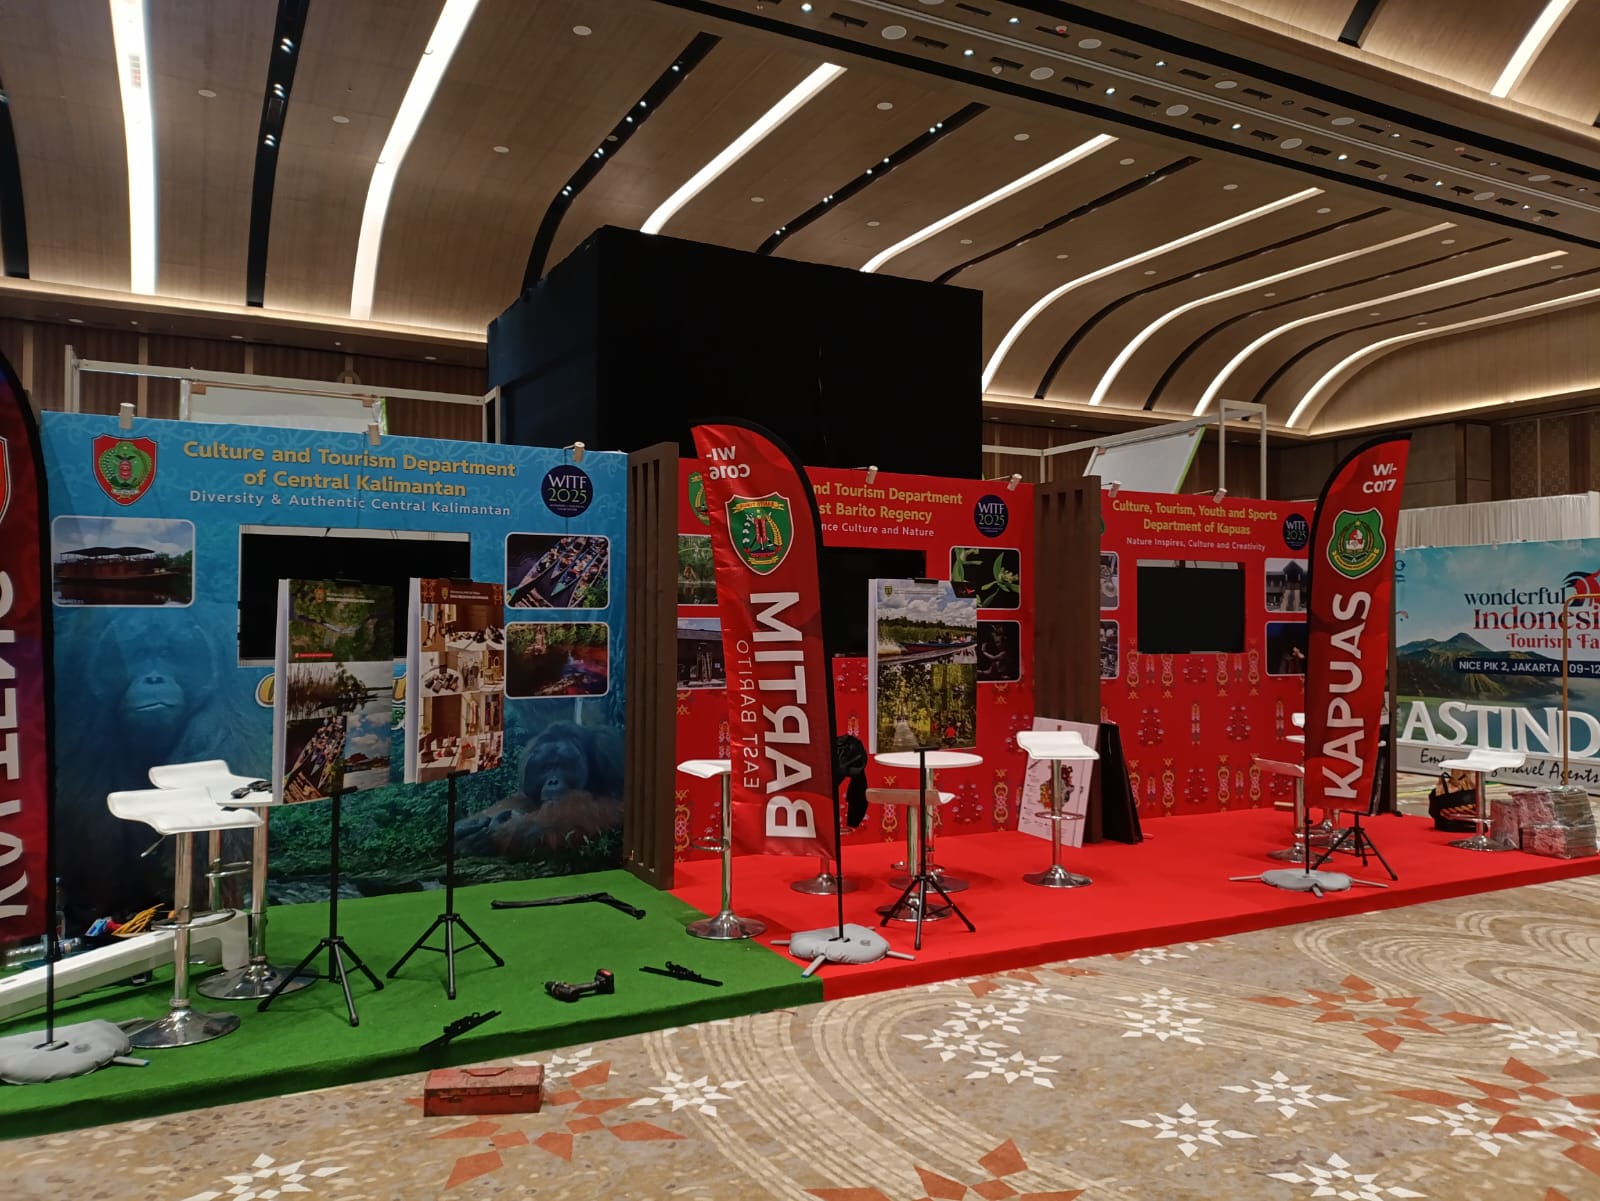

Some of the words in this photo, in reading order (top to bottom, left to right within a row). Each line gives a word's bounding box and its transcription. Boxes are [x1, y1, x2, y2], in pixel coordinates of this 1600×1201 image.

[183, 440, 265, 461] Culture
[271, 447, 311, 463] and
[318, 448, 396, 469] Tourism
[403, 454, 516, 477] Department
[243, 468, 267, 486] of
[273, 470, 349, 490] Central
[356, 474, 467, 497] Kalimantan
[548, 473, 587, 489] WITF
[189, 489, 265, 507] Diversity
[271, 493, 282, 505] &
[289, 495, 365, 509] Authentic
[371, 498, 426, 512] Central
[432, 501, 511, 516] Kalimantan
[547, 487, 587, 505] 2025
[813, 482, 831, 495] nd
[834, 482, 885, 499] Tourism
[889, 487, 963, 505] Department
[819, 502, 832, 515] st
[836, 502, 876, 517] Barito
[880, 505, 933, 525] Regency
[978, 501, 1005, 515] WITF
[1112, 500, 1152, 514] Culture,
[1155, 502, 1195, 516] Tourism,
[1198, 505, 1226, 518] Youth
[1228, 507, 1246, 519] and
[1248, 508, 1278, 522] Sports
[841, 522, 878, 534] Culture
[881, 526, 899, 535] and
[902, 526, 935, 537] Nature
[978, 513, 1005, 528] 2025
[1143, 518, 1201, 533] Department
[1204, 521, 1215, 533] of
[1217, 522, 1251, 536] Kapuas
[1126, 537, 1152, 546] Nature
[1188, 539, 1215, 549] Culture
[1216, 540, 1230, 549] and
[1231, 541, 1266, 552] Creativity
[1464, 586, 1566, 606] wonderful
[1506, 633, 1572, 649] Tourism
[1459, 661, 1481, 670] NICE
[1483, 661, 1499, 671] PIK
[1511, 662, 1560, 673] JAKARTA
[1321, 590, 1372, 799] KAPUAS
